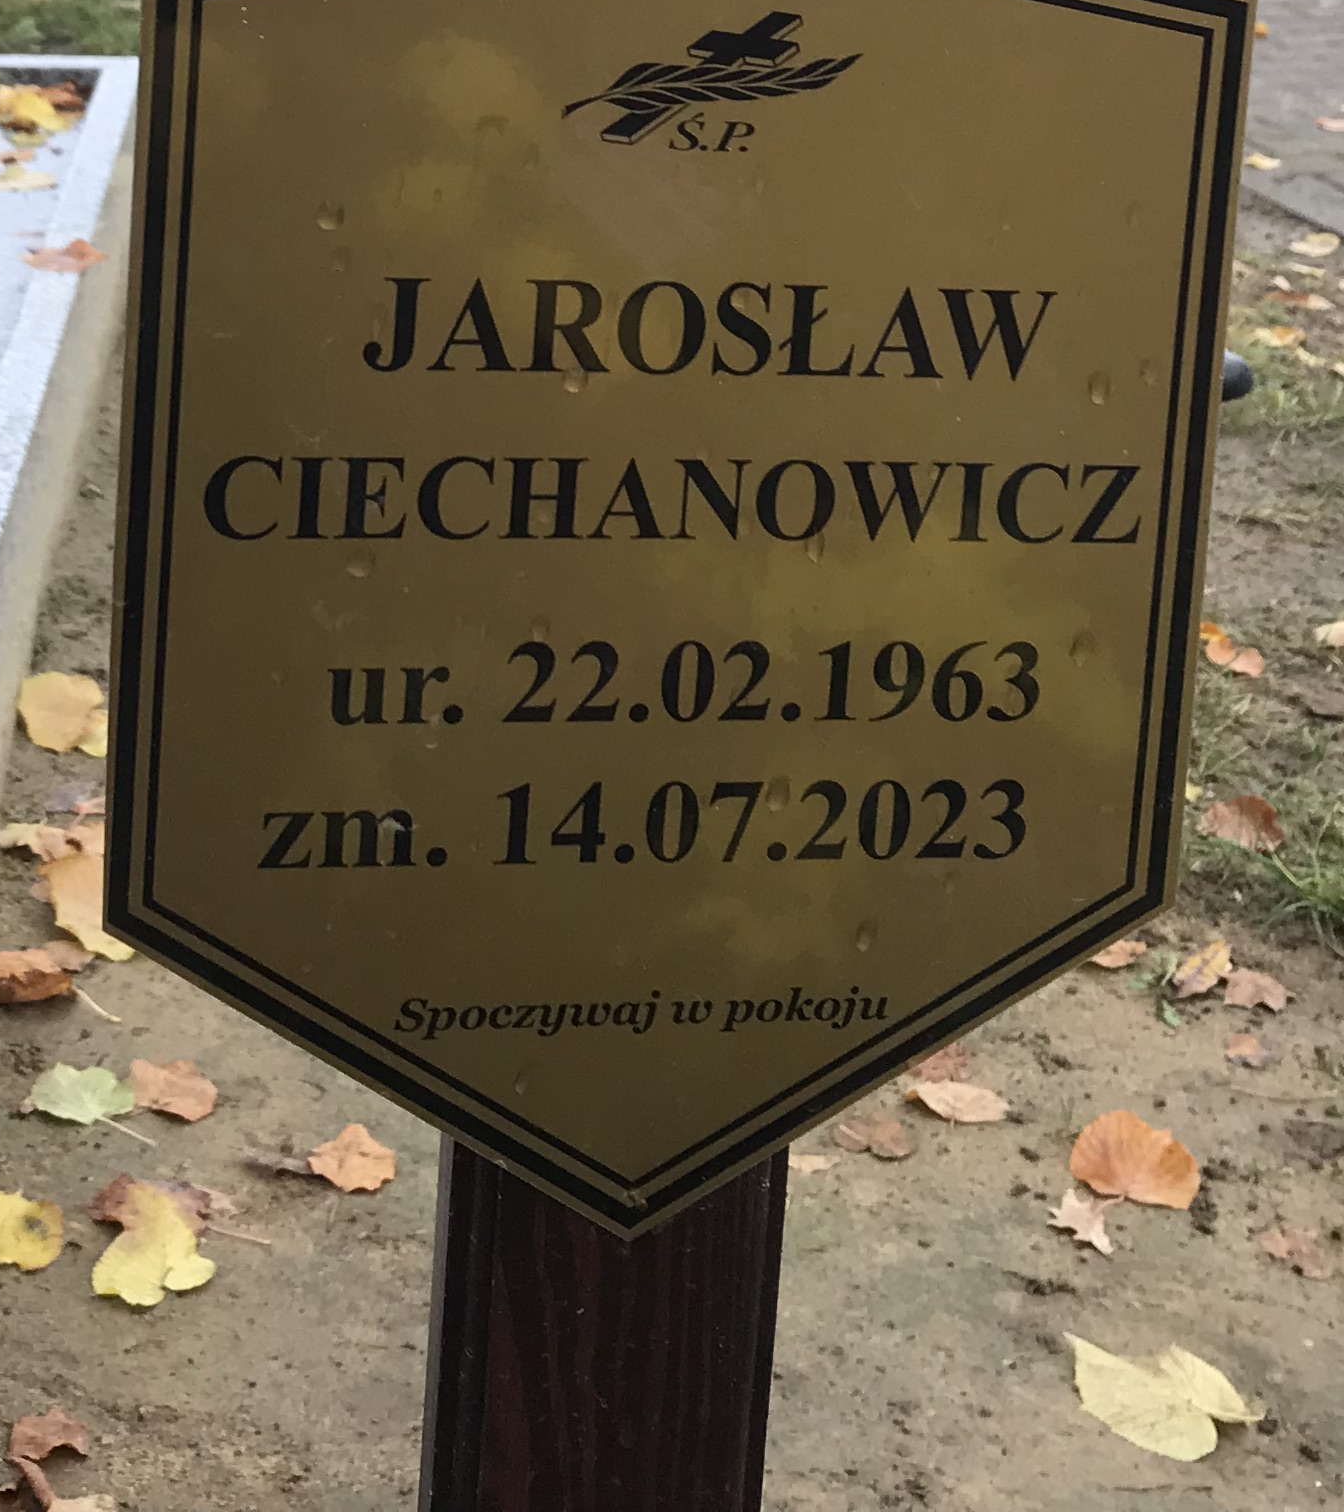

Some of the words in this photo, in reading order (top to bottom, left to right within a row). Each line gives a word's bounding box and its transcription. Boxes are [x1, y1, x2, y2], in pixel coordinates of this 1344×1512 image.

[361, 276, 1058, 382] JAROSŁAW
[202, 454, 1142, 546] CIECHANOWICZ
[328, 665, 465, 726] ur.
[502, 639, 1041, 724] 22.02.1963
[257, 808, 449, 870] zm.
[492, 778, 1027, 867] 14.07.2023
[394, 990, 660, 1039] Spoczywaj
[671, 999, 713, 1025] w
[720, 986, 890, 1032] pokoju
